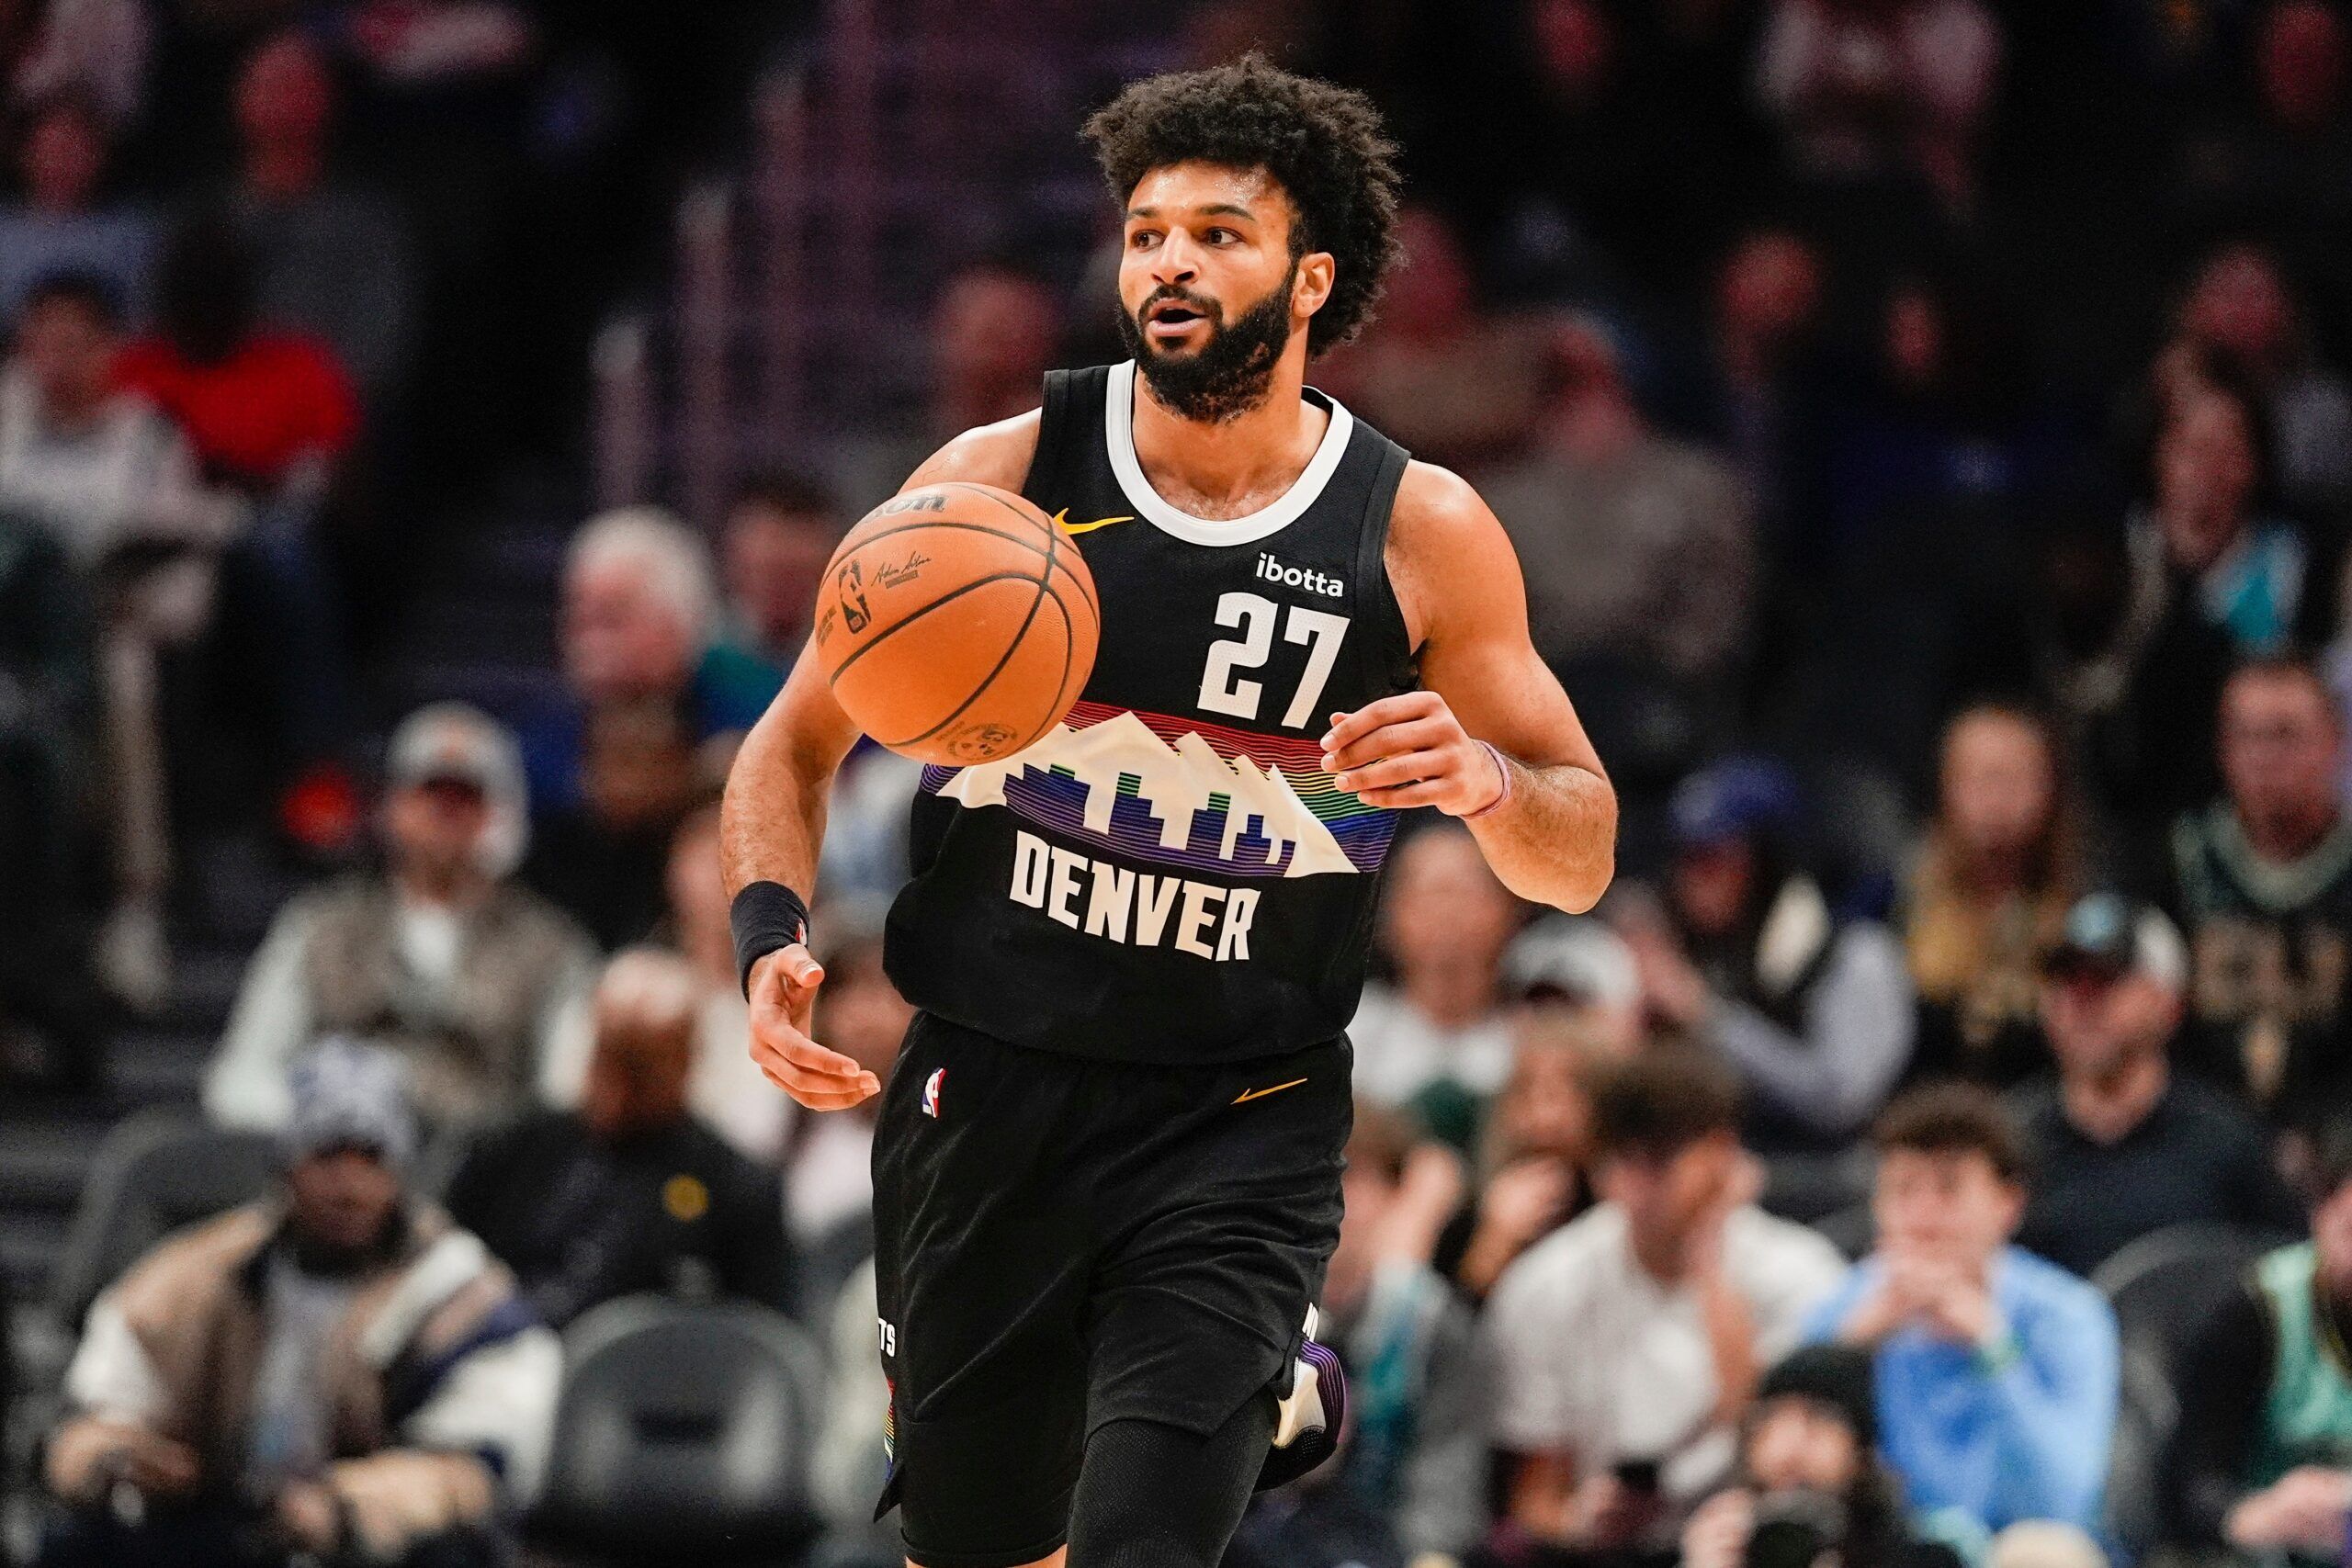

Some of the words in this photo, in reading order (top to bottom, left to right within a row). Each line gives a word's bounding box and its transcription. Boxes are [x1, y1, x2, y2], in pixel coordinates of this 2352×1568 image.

[1255, 552, 1344, 597] ibotta
[1197, 592, 1351, 729] 27
[1010, 829, 1261, 962] DENVER
